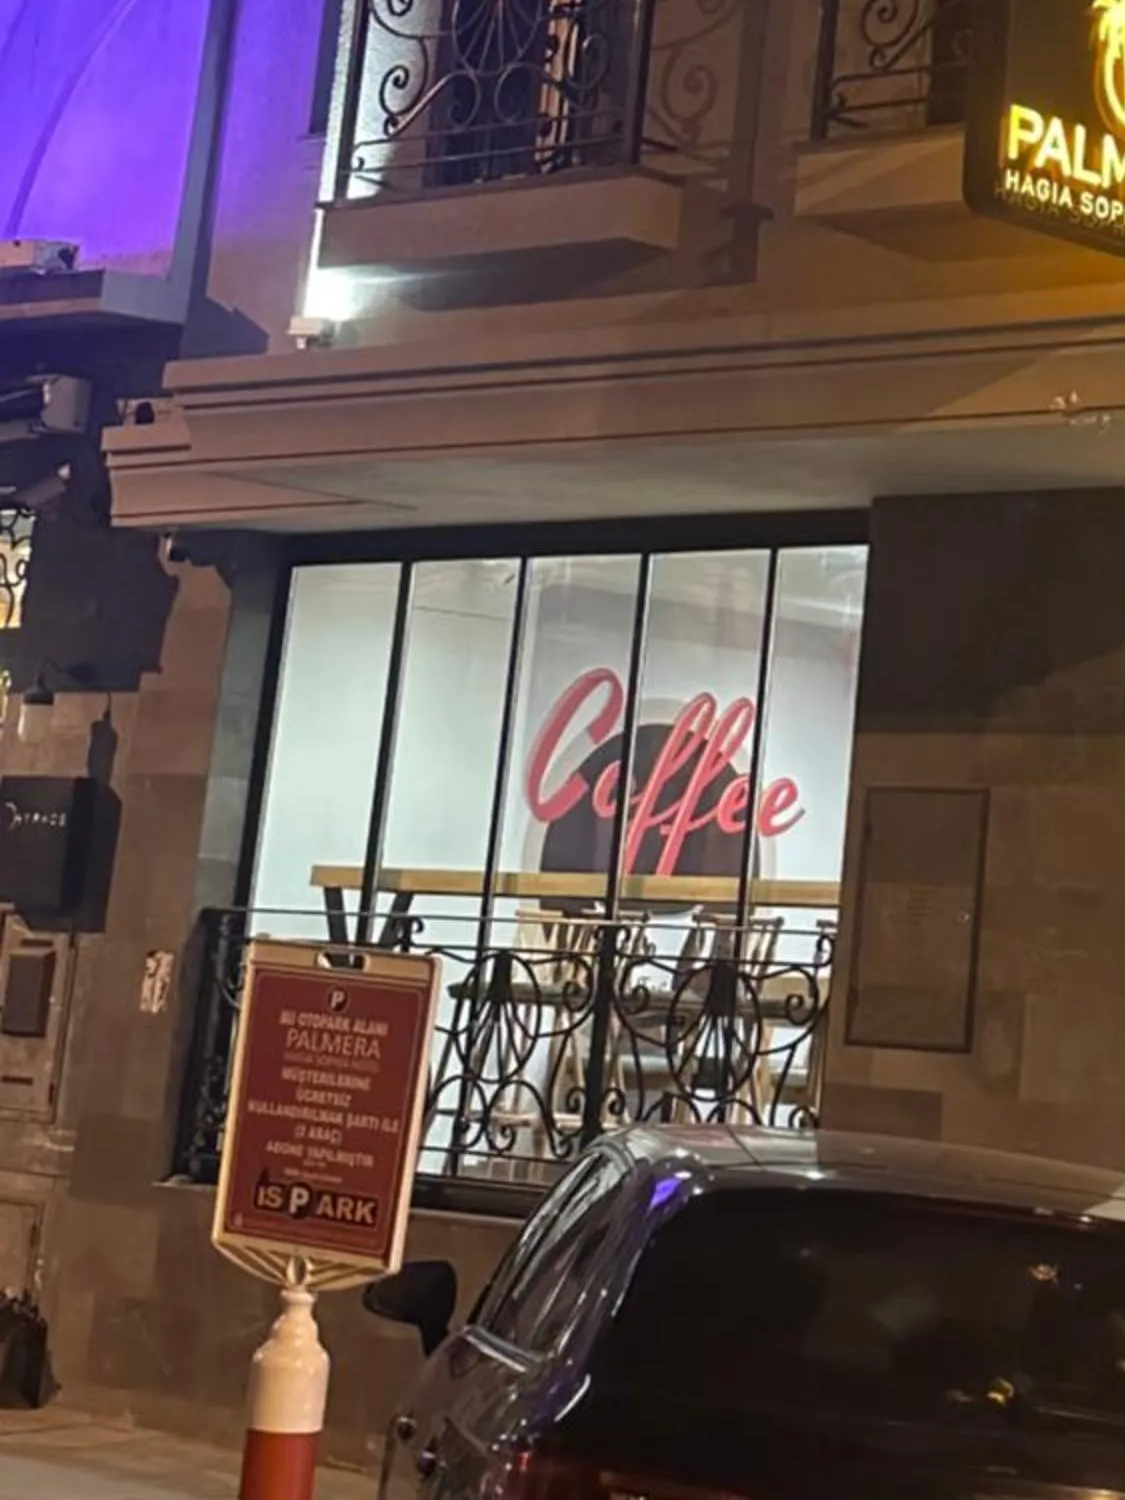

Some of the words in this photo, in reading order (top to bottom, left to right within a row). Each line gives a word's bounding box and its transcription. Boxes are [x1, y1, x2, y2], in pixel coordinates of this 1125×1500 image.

[1005, 169, 1074, 209] HAGIA
[525, 667, 806, 877] Coffee
[331, 989, 345, 1009] P
[285, 1027, 381, 1060] PALMERA
